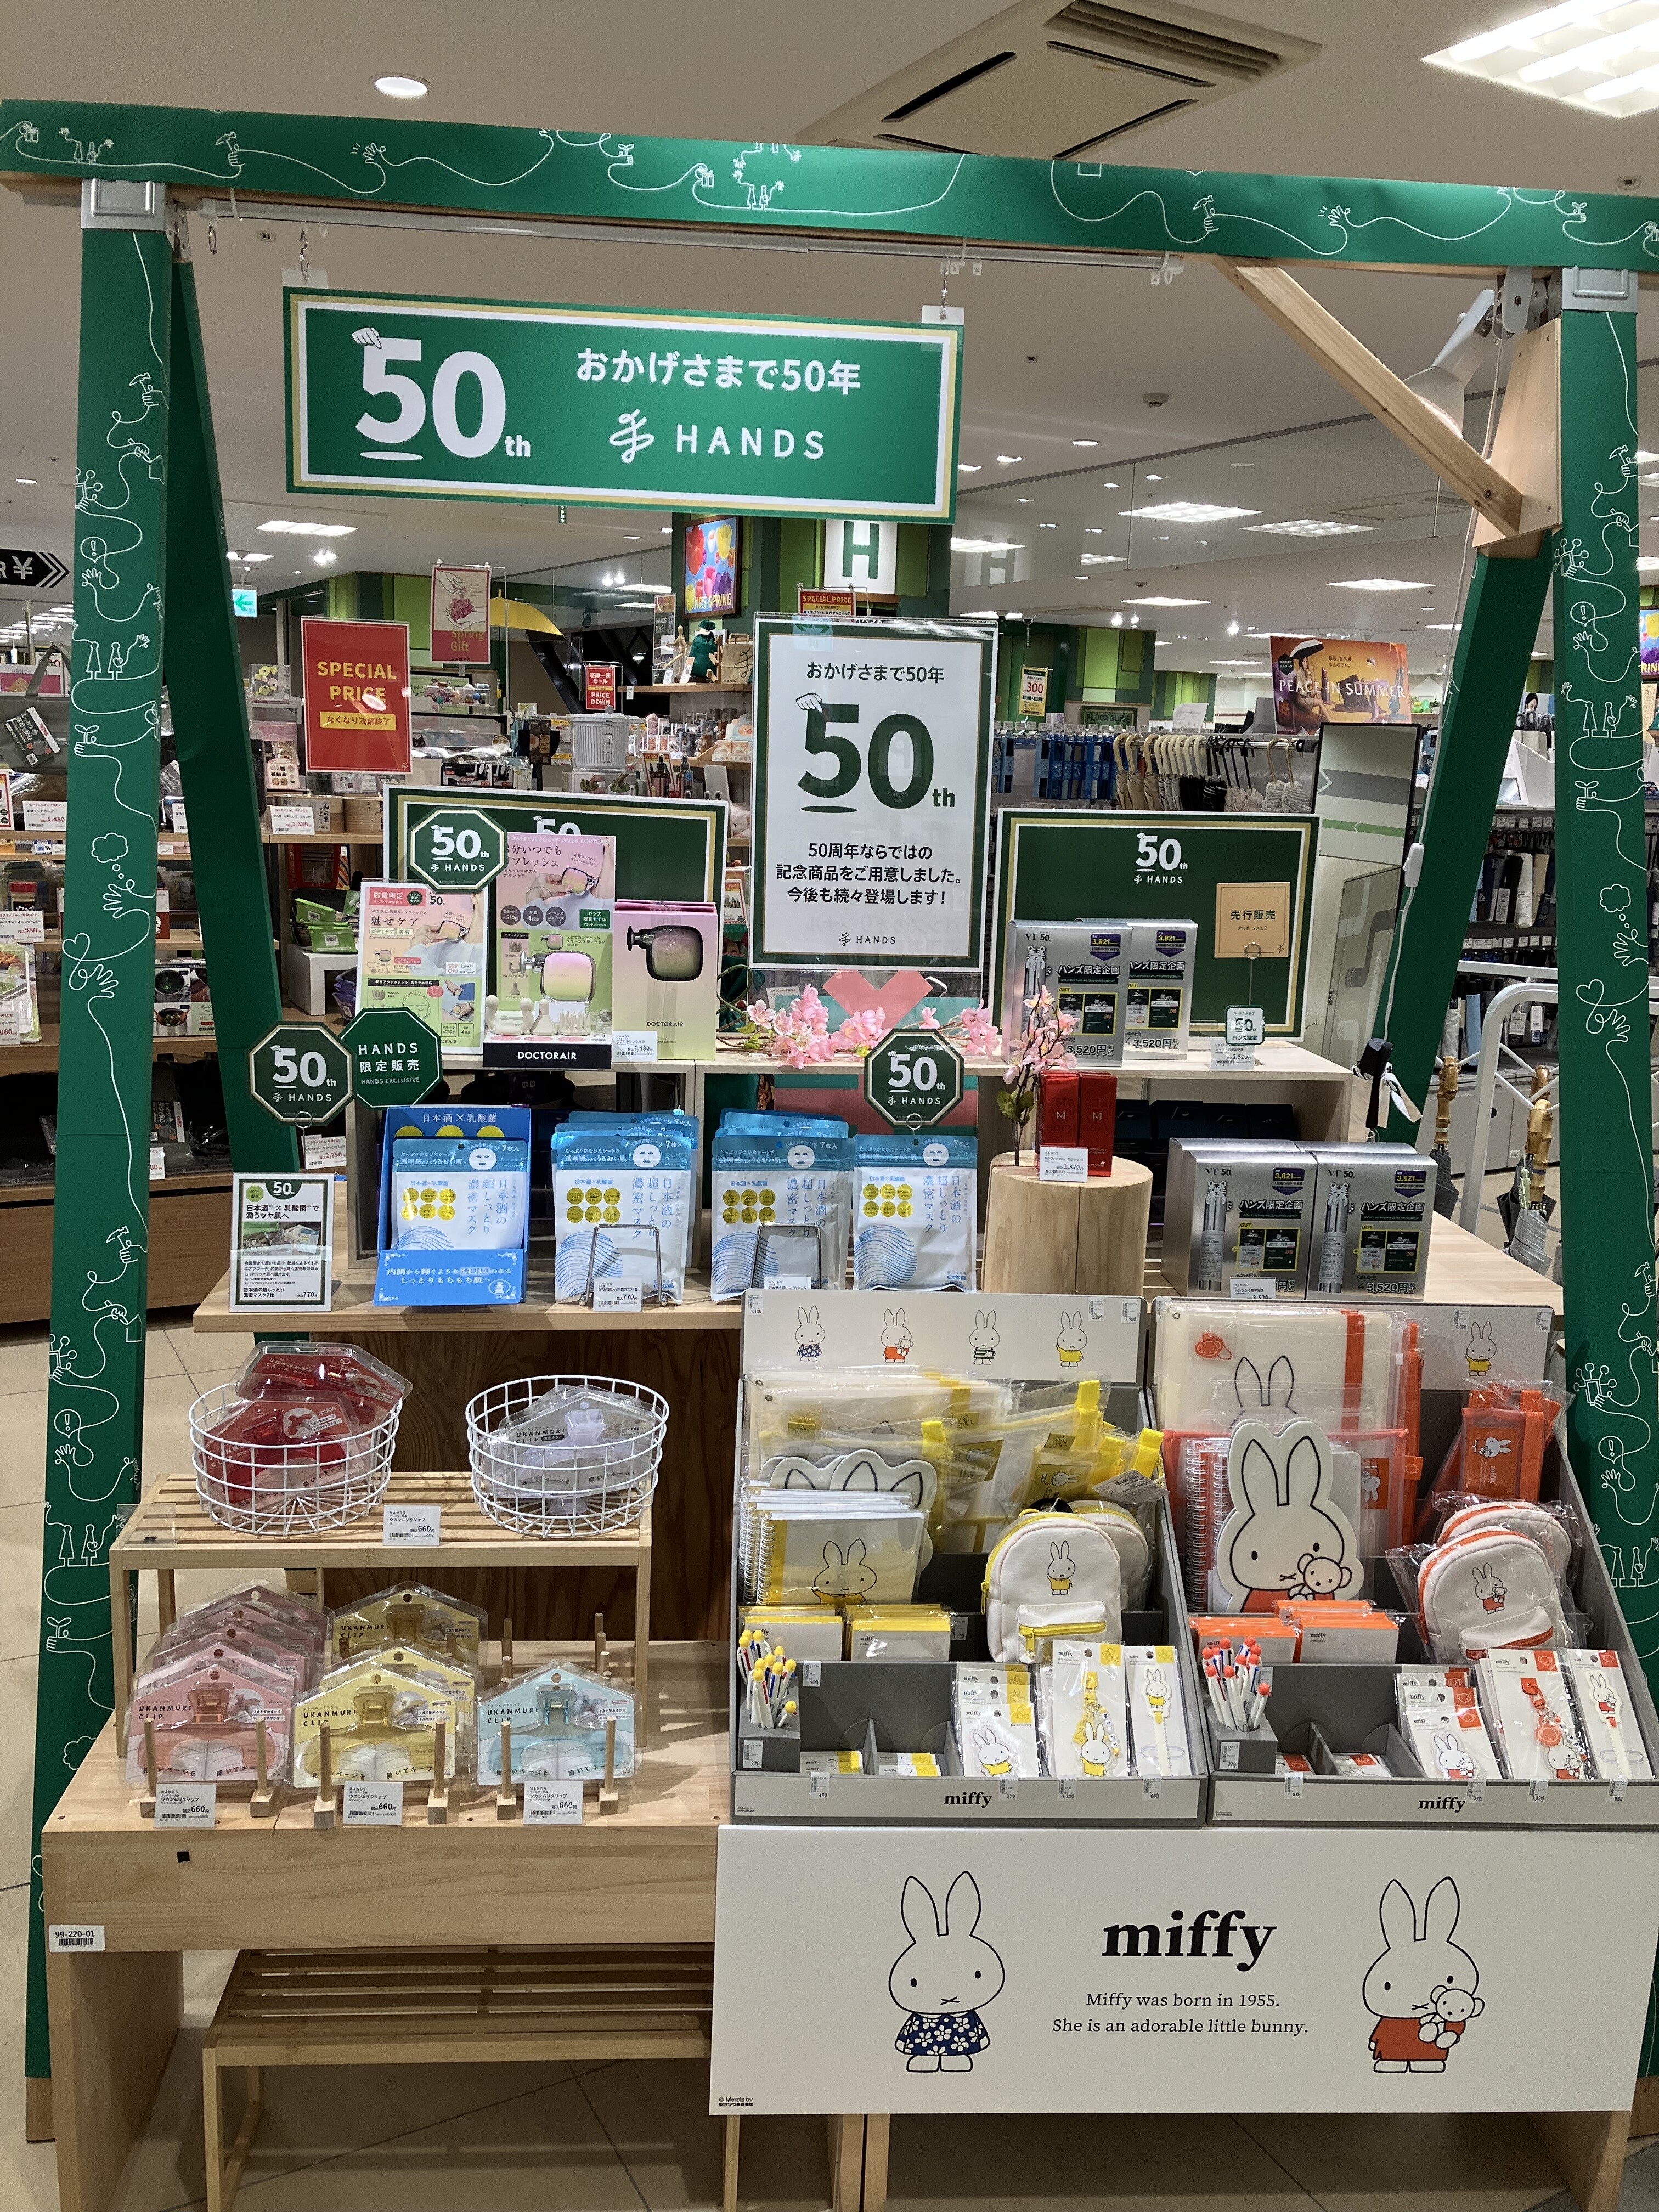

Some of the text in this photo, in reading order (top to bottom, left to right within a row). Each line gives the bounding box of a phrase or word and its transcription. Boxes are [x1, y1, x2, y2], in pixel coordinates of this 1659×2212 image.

[577, 348, 862, 396] おかげさまで50年
[356, 337, 532, 459] 50th
[676, 424, 825, 460] HANDS
[843, 521, 880, 579] H
[709, 593, 731, 608] SPRING
[451, 629, 484, 641] Spring
[450, 641, 470, 651] Gift
[317, 661, 397, 680] SPECIAL
[807, 662, 945, 684] おかげさまで50年
[330, 684, 386, 702] PRICE
[1027, 682, 1043, 693] 300
[1279, 679, 1406, 698] PEACE IN SUMMER
[326, 715, 391, 727] なくなり次第終了
[1087, 714, 1131, 723] FLOOR GUIDE
[797, 703, 956, 809] 50th
[431, 827, 490, 860] 50th
[808, 842, 933, 860] 50周年ならではの
[1136, 836, 1188, 871] 50th
[445, 864, 486, 872] HANDS
[776, 864, 963, 884] 記念商品をご用意しました。
[1147, 875, 1183, 884] HANDS
[373, 891, 404, 900] 数量限定
[787, 887, 945, 906] 今後も続々登場します!
[371, 916, 419, 926] 魅せケア
[1231, 910, 1276, 921] 先行販売
[856, 935, 896, 945] HANDS
[1058, 964, 1121, 976] ハンズ限定企画
[358, 1042, 418, 1056] HANDS
[1066, 1045, 1107, 1056] 3,520円
[1133, 1039, 1172, 1049] 3,520円
[517, 1051, 577, 1060] DOCTORAIR
[272, 1047, 336, 1087] 50th
[359, 1059, 420, 1073] 限定販売
[888, 1053, 945, 1091] 50th
[289, 1093, 332, 1102] HANDS
[901, 1097, 941, 1105] HANDS
[674, 1118, 691, 1127] 7枚入
[1056, 1111, 1066, 1120] M
[1092, 1111, 1102, 1120] M
[502, 1144, 520, 1153] 7枚入
[665, 1139, 683, 1148] 7枚入
[820, 1141, 838, 1149] 7枚入
[953, 1139, 970, 1148] 7枚入
[1328, 1169, 1342, 1177] VT
[467, 1178, 479, 1235] 濃密マスク
[482, 1178, 495, 1235] 超しっとり
[496, 1178, 509, 1225] 日本酒の
[661, 1178, 673, 1229] 日本酒の
[815, 1178, 827, 1228] 日本酒の
[922, 1175, 935, 1233] 濃密マスク
[936, 1175, 949, 1233] 超しっとり
[950, 1175, 962, 1224] 日本酒の
[1239, 1199, 1304, 1210] ハンズ限定企画
[1361, 1201, 1425, 1212] ハンズ限定企画
[631, 1177, 644, 1239] 濃密マスク
[646, 1177, 659, 1240] 超しっとり
[787, 1178, 799, 1238] 濃密マスク
[801, 1178, 813, 1238] 超しっとり
[1367, 1282, 1408, 1294] 3,520円
[516, 1429, 566, 1437] UKANMURI
[303, 1710, 357, 1718] UKANMURI
[487, 1707, 538, 1716] UKANMURI
[944, 1792, 992, 1808] miffy
[1419, 1796, 1465, 1813] miffy
[55, 1930, 95, 1938] 99-220-01
[1102, 1910, 1277, 1972] miffy
[1086, 1993, 1279, 2009] Miffy was born in 1955.
[1053, 2018, 1308, 2036] She is an adorable little bunny.
